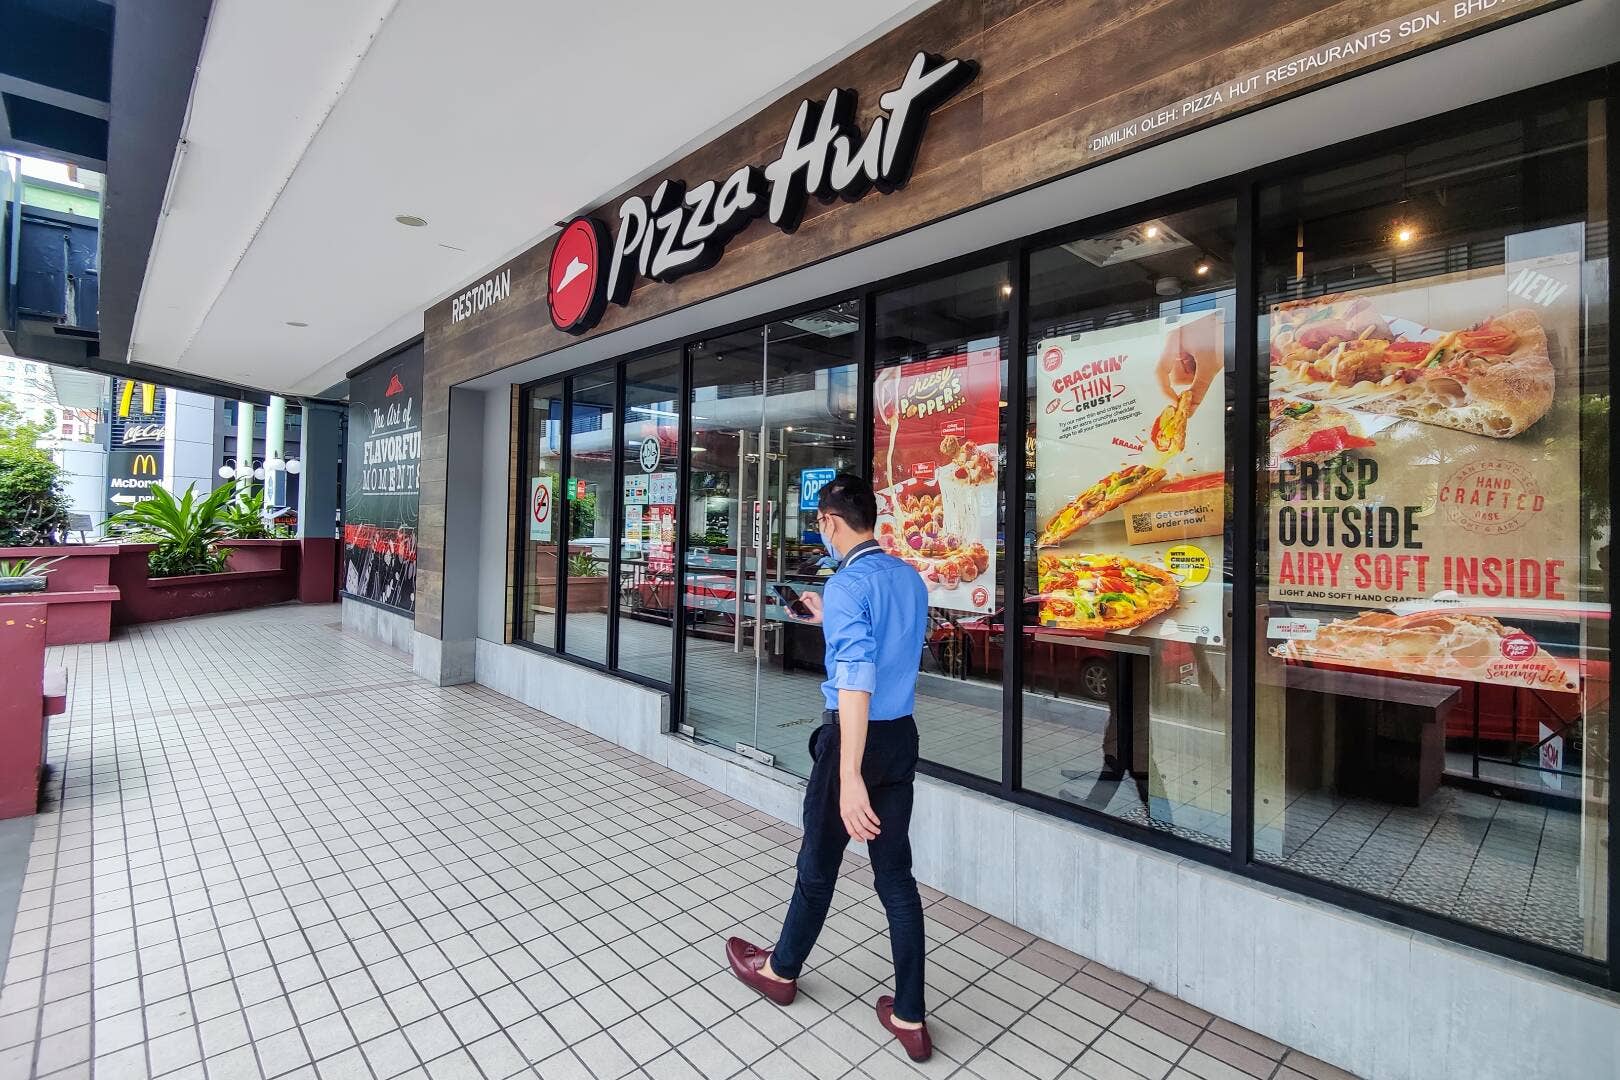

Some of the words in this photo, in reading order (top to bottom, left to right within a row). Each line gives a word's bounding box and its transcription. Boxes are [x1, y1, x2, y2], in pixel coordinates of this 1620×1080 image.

[1141, 108, 1179, 132] OLEH:
[1182, 91, 1223, 117] PIZZA
[1229, 75, 1261, 99] HUT
[1265, 28, 1391, 85] RESTAURANTS
[1398, 10, 1446, 38] SDN.
[607, 178, 757, 302] Pizza
[764, 51, 960, 224] Hut
[452, 268, 511, 325] RESTORAN
[1506, 267, 1568, 306] NEW
[1070, 375, 1112, 403] THIN
[947, 396, 966, 414] PIZZA
[1075, 393, 1112, 412] CRUST
[372, 407, 385, 434] The
[387, 402, 400, 427] Art
[402, 397, 412, 429] of
[1111, 437, 1144, 452] KRAAAK
[804, 479, 830, 501] OP
[1278, 457, 1379, 502] CRISP
[1476, 476, 1511, 490] HAND
[1439, 486, 1545, 512] CRAFTED
[1156, 511, 1172, 520] Get
[1156, 519, 1181, 529] order
[1183, 515, 1206, 525] now!
[1278, 506, 1424, 549] OUTSIDE
[1279, 551, 1343, 588] AIRY
[1353, 553, 1431, 592] SOFT
[1443, 555, 1566, 601] INSIDE
[1279, 589, 1304, 597] LIGHT
[1328, 592, 1351, 600] SOFT
[1354, 594, 1382, 602] HAND
[1506, 644, 1529, 652] Pizza
[1485, 668, 1538, 685] Senang
